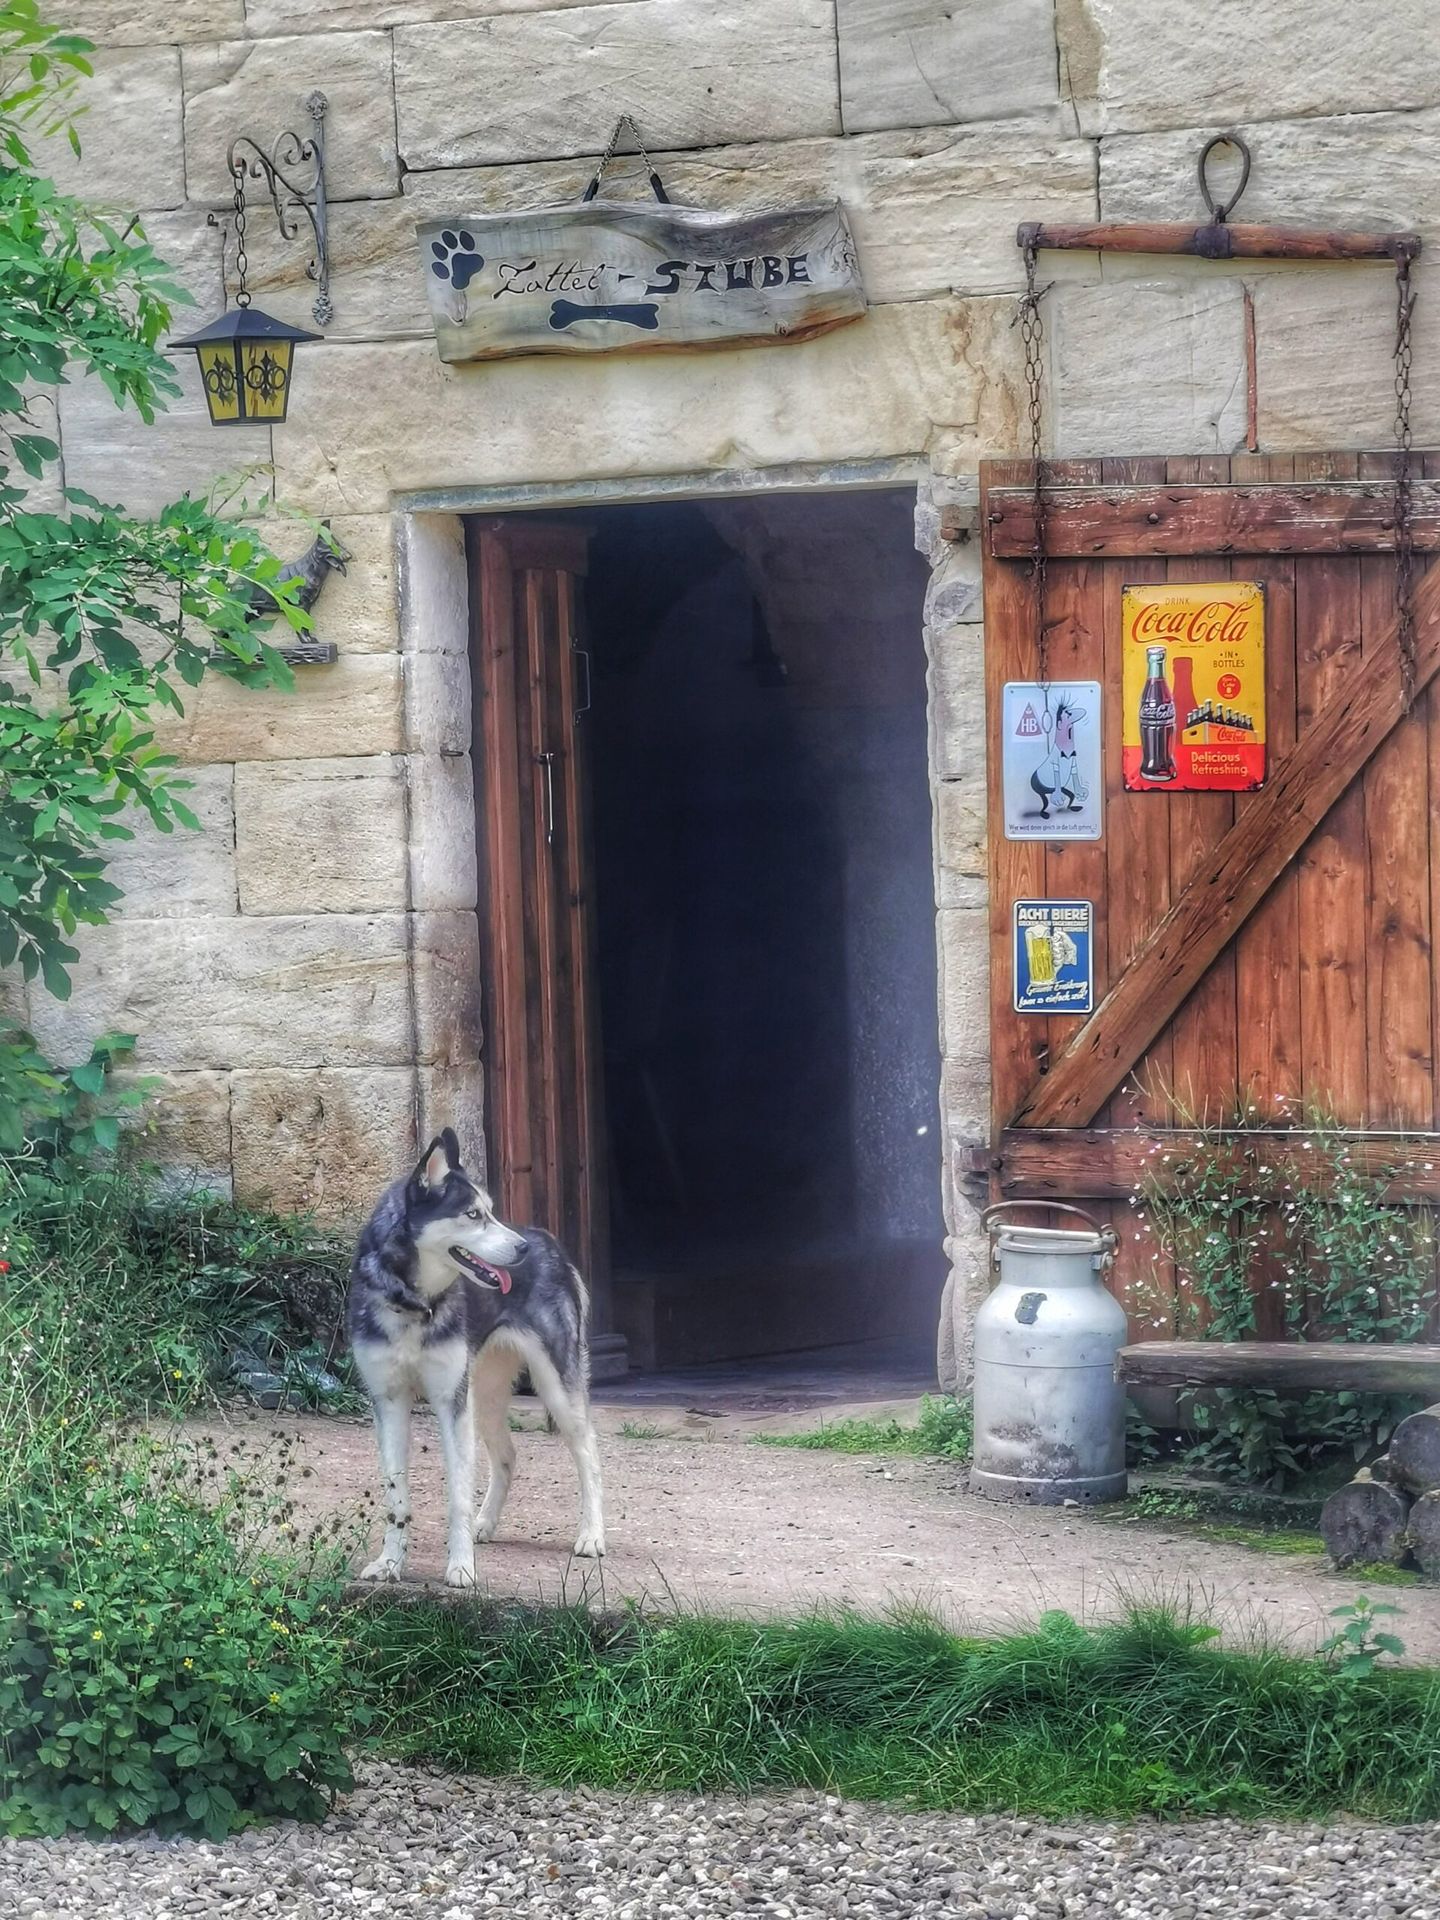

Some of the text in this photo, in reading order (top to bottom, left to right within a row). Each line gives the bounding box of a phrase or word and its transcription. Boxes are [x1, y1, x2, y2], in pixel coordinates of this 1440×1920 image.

[643, 252, 814, 297] STUBE
[1165, 597, 1190, 605] DRINK
[1131, 602, 1254, 643] Coca-Cola
[1213, 660, 1245, 668] BOTTLES
[1020, 718, 1038, 733] HB
[1191, 751, 1241, 762] Delicious
[1192, 763, 1249, 777] Refreshing
[1018, 908, 1089, 921] ACHT BIERE
